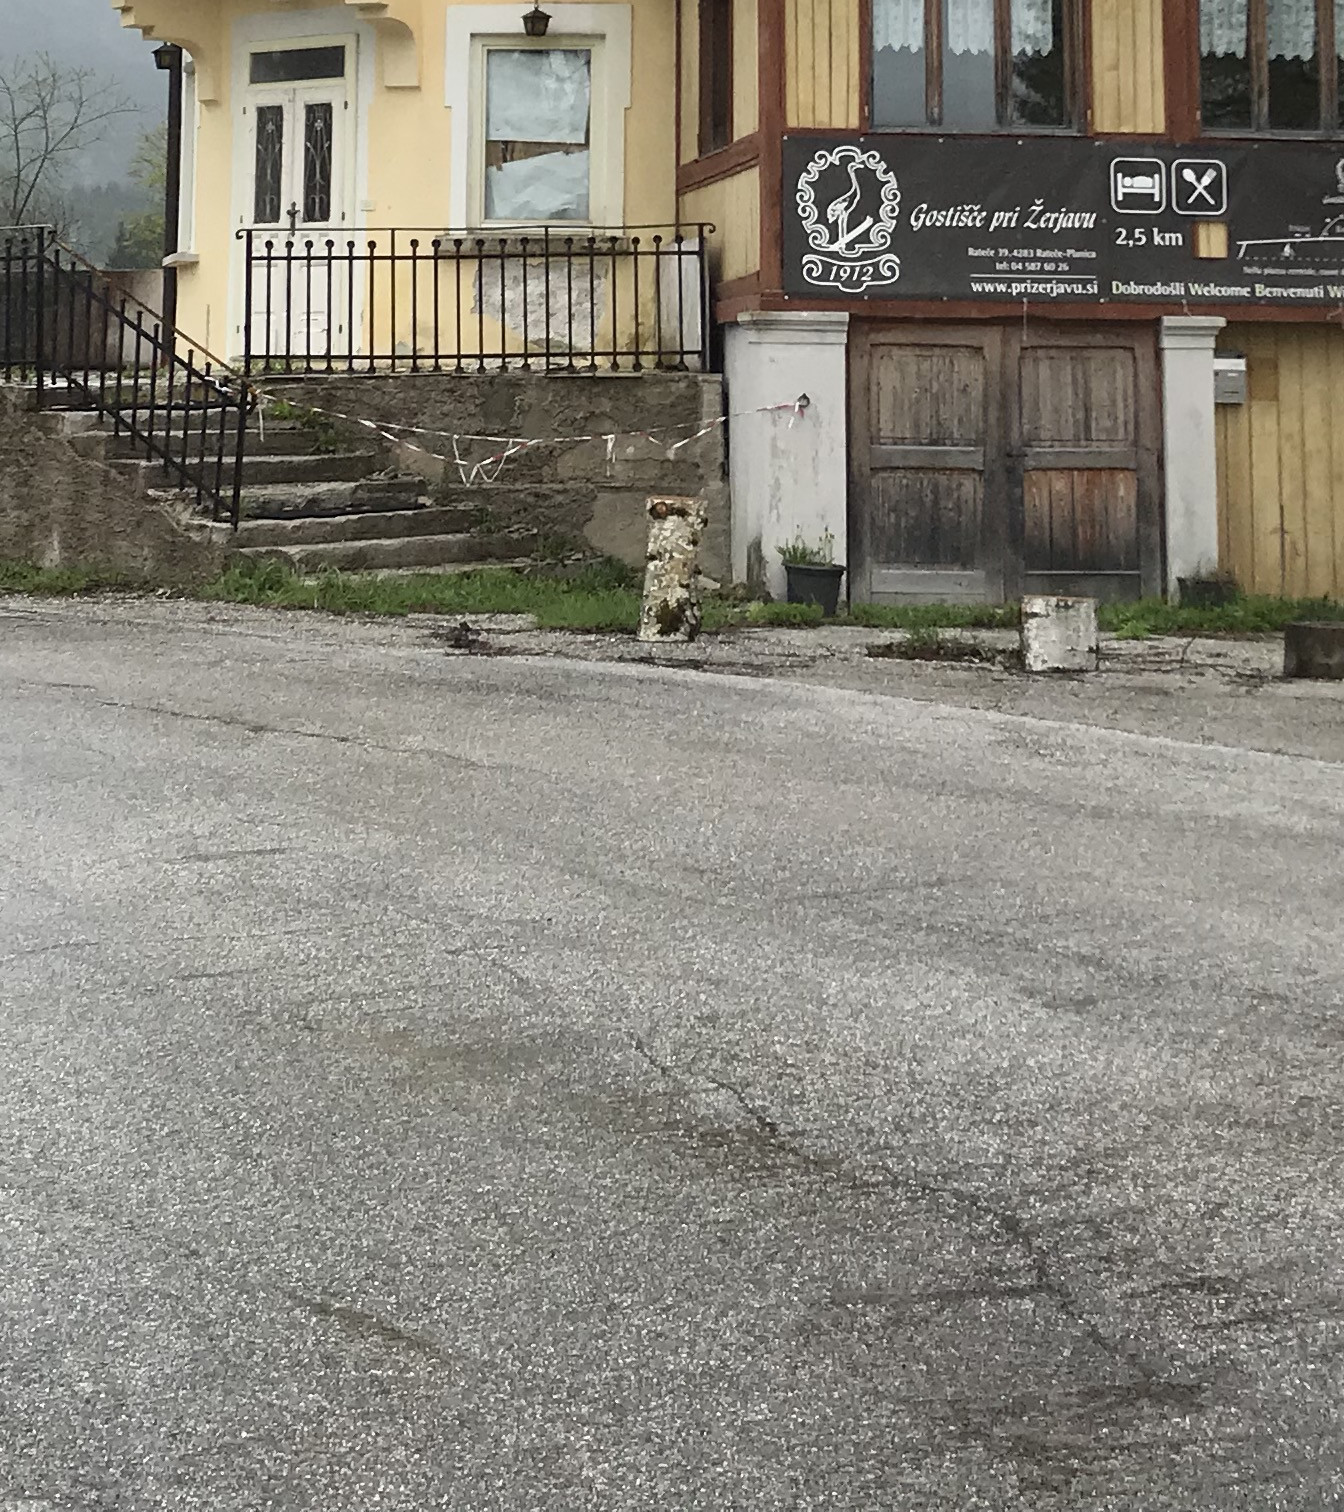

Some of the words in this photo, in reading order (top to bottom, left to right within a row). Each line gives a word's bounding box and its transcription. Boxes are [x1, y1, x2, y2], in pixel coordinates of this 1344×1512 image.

[910, 203, 987, 232] Gostišče
[988, 205, 1019, 233] pri
[1023, 198, 1099, 233] Žerjavu
[1115, 227, 1147, 249] 2,5
[1152, 226, 1184, 247] km
[828, 265, 874, 283] 1912
[970, 279, 1099, 297] www.prizerjavu.si
[1111, 281, 1185, 296] Dobrodošli
[1189, 282, 1251, 297] Welcome
[1255, 284, 1324, 299] Benvenuti
